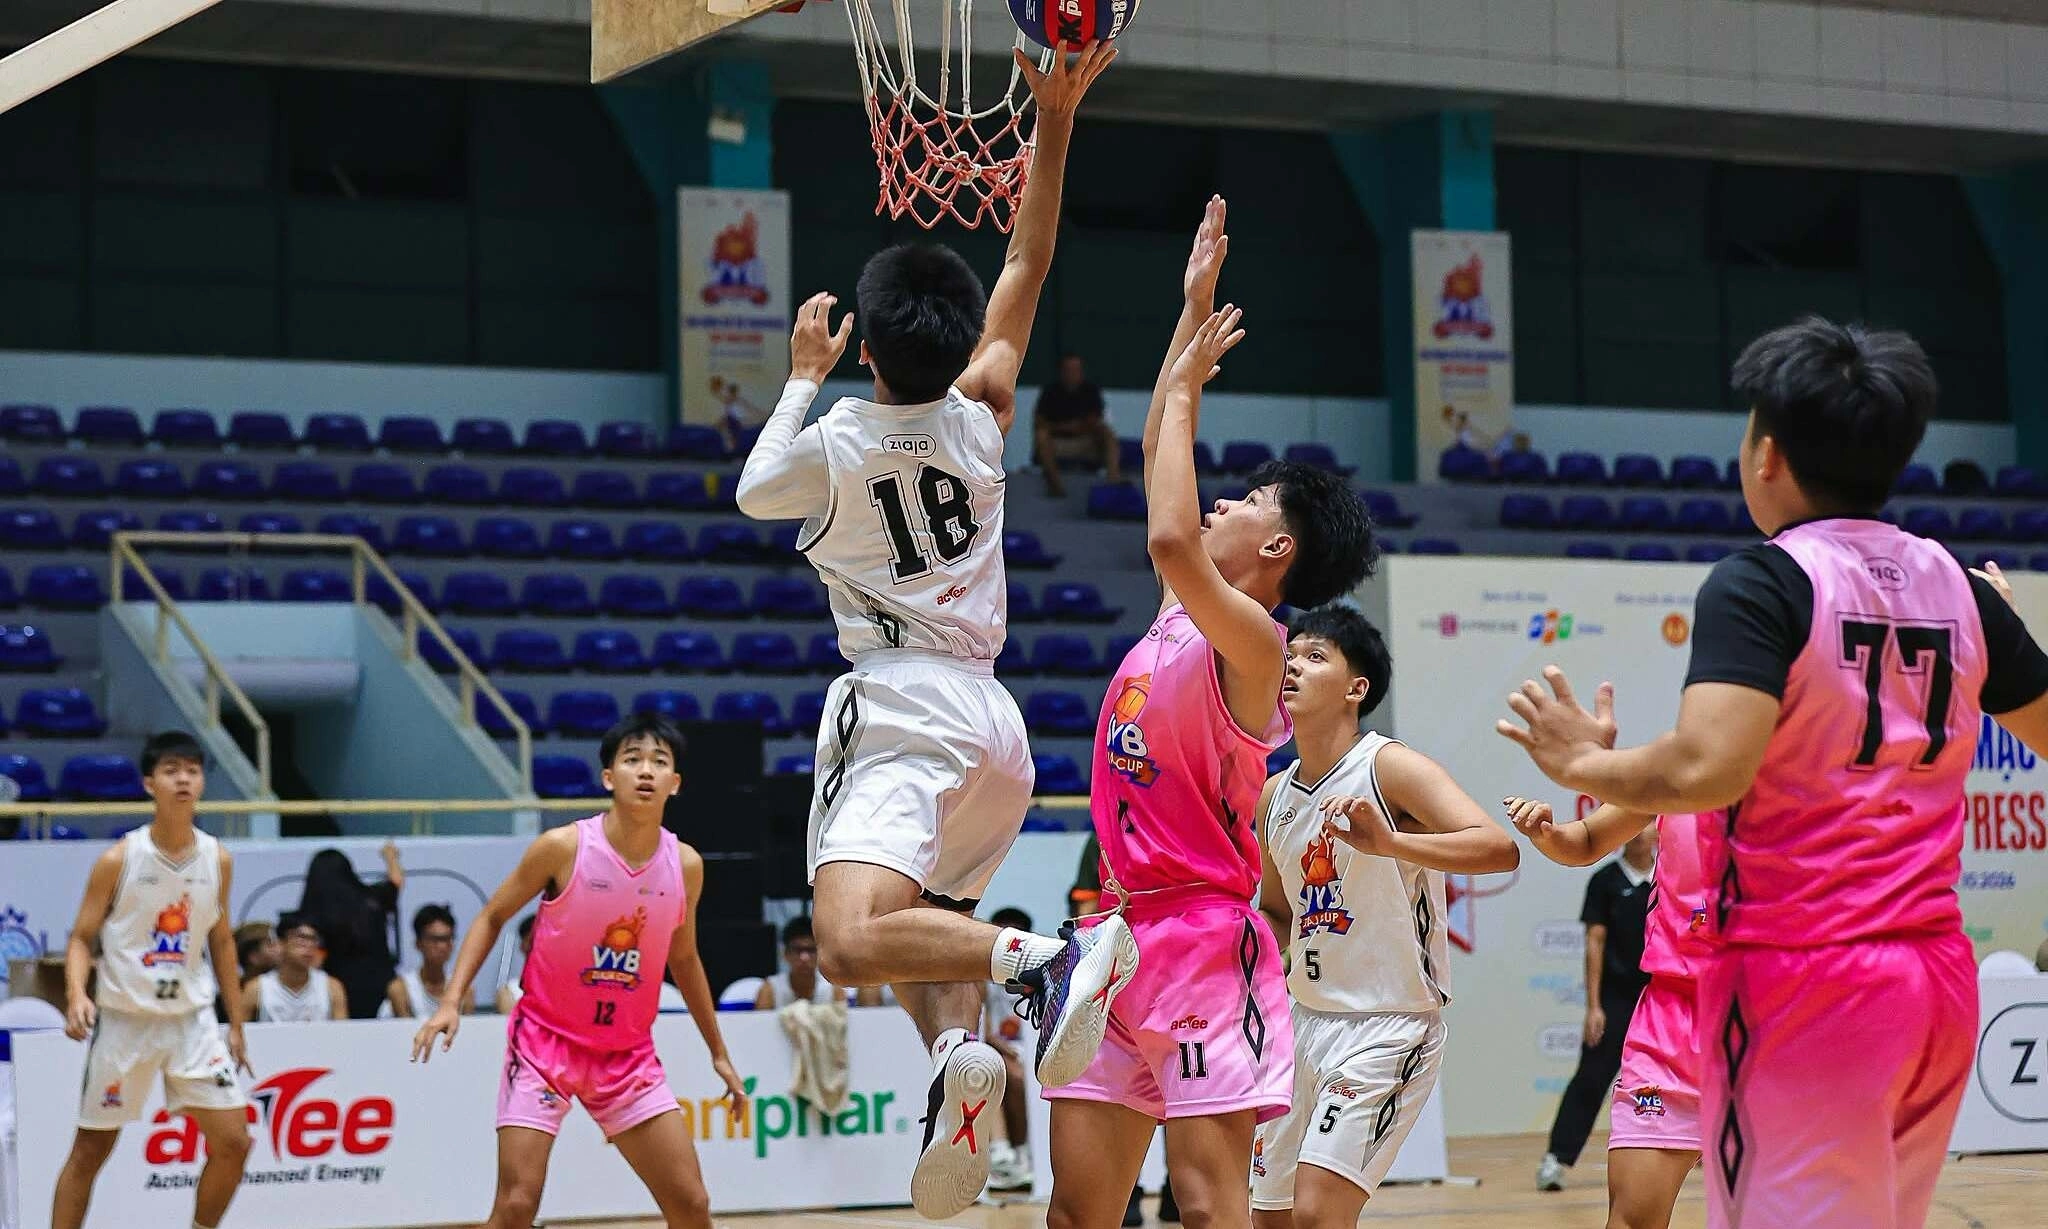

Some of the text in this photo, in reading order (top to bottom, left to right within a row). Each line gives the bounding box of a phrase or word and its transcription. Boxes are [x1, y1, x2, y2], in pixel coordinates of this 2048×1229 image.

[867, 463, 981, 584] 18
[1837, 614, 1957, 770] 77
[1965, 794, 2047, 851] RESS
[592, 944, 641, 973] VYB
[1304, 948, 1322, 982] 5
[156, 979, 180, 999] 22
[594, 1001, 615, 1025] 12
[1177, 1040, 1208, 1081] 11
[1320, 1103, 1342, 1135] 5
[317, 1163, 384, 1184] Energy
